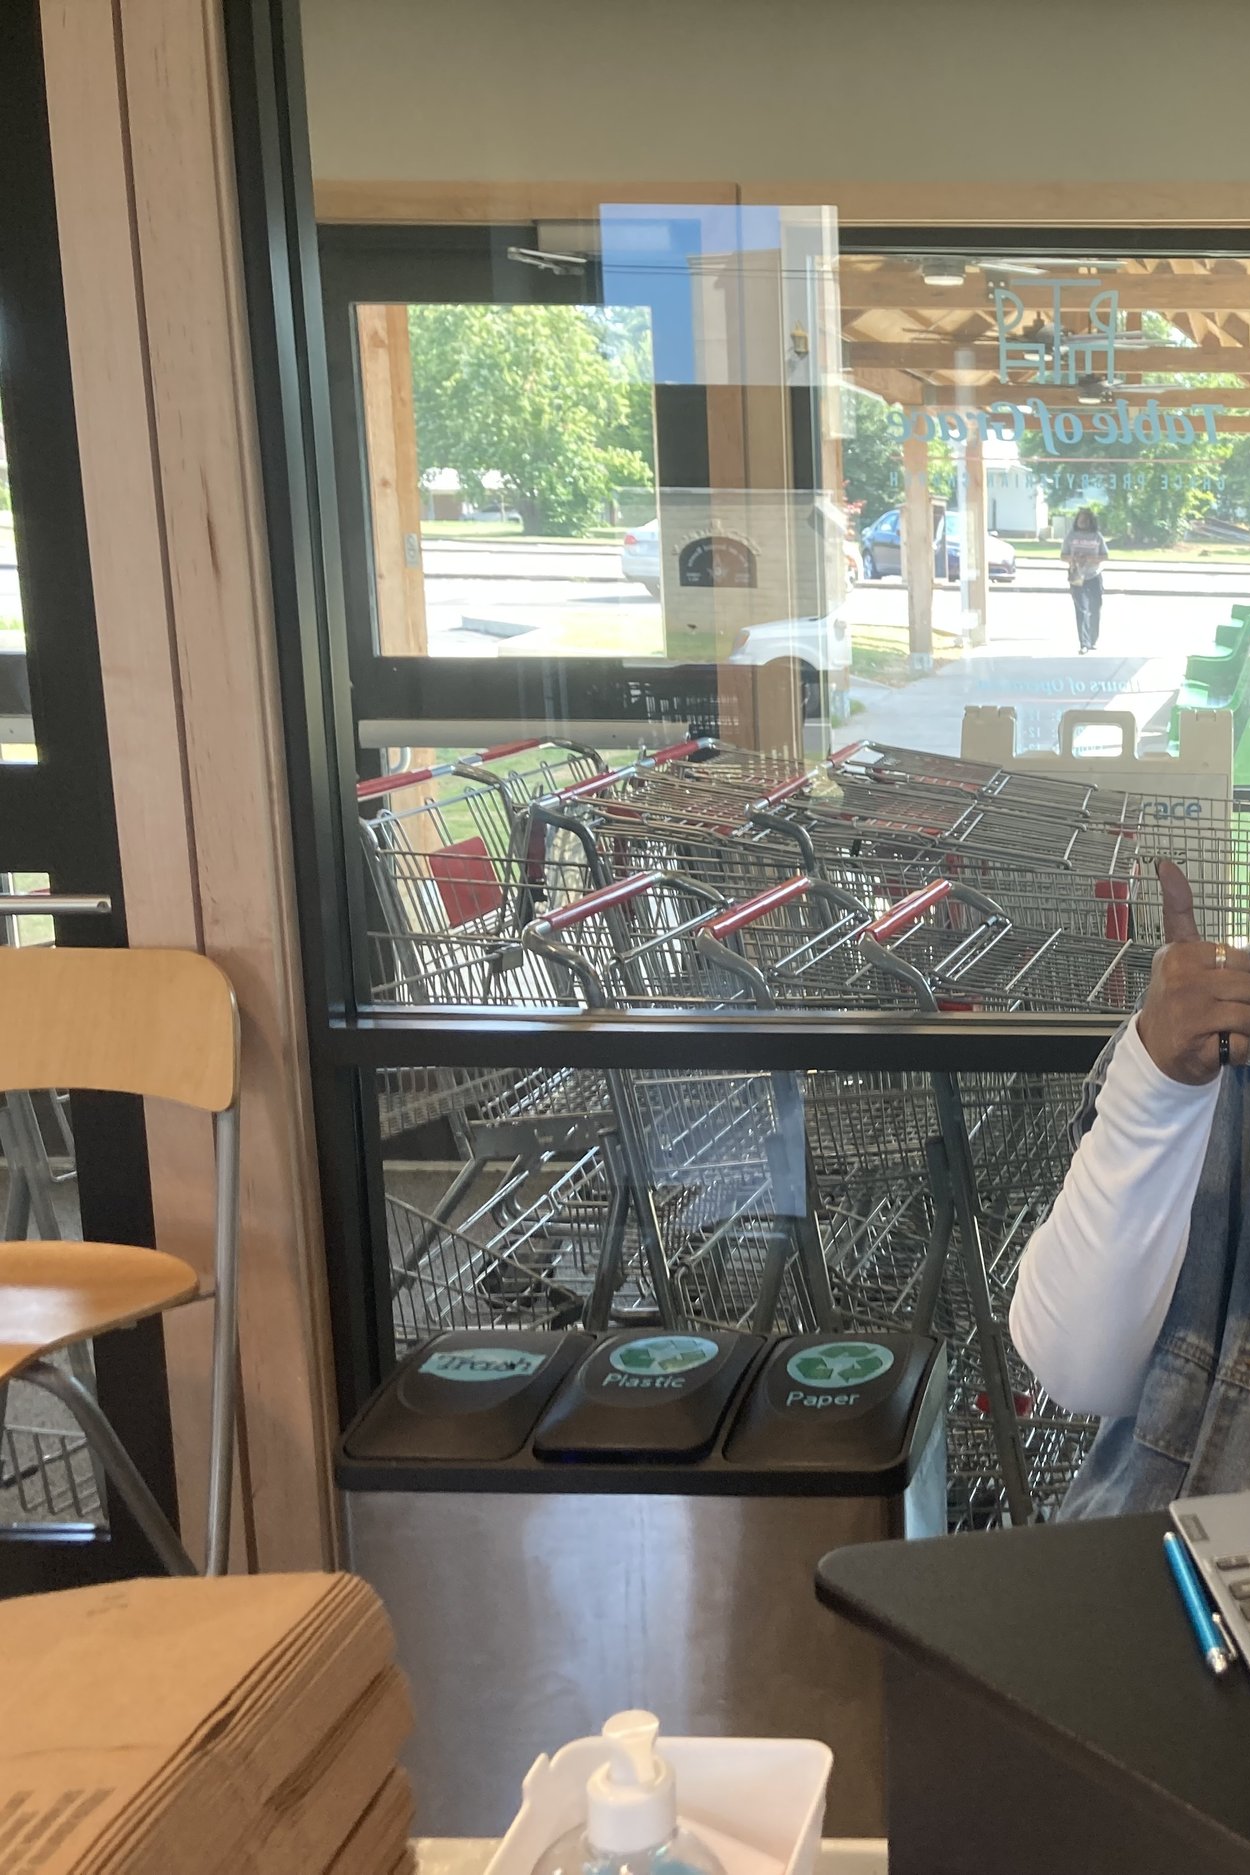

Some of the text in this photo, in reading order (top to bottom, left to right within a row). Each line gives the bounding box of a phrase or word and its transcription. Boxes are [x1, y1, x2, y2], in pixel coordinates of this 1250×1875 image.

[1143, 801, 1202, 821] race
[436, 1354, 532, 1372] Trash
[602, 1371, 686, 1390] Plastic
[786, 1390, 861, 1408] Paper
